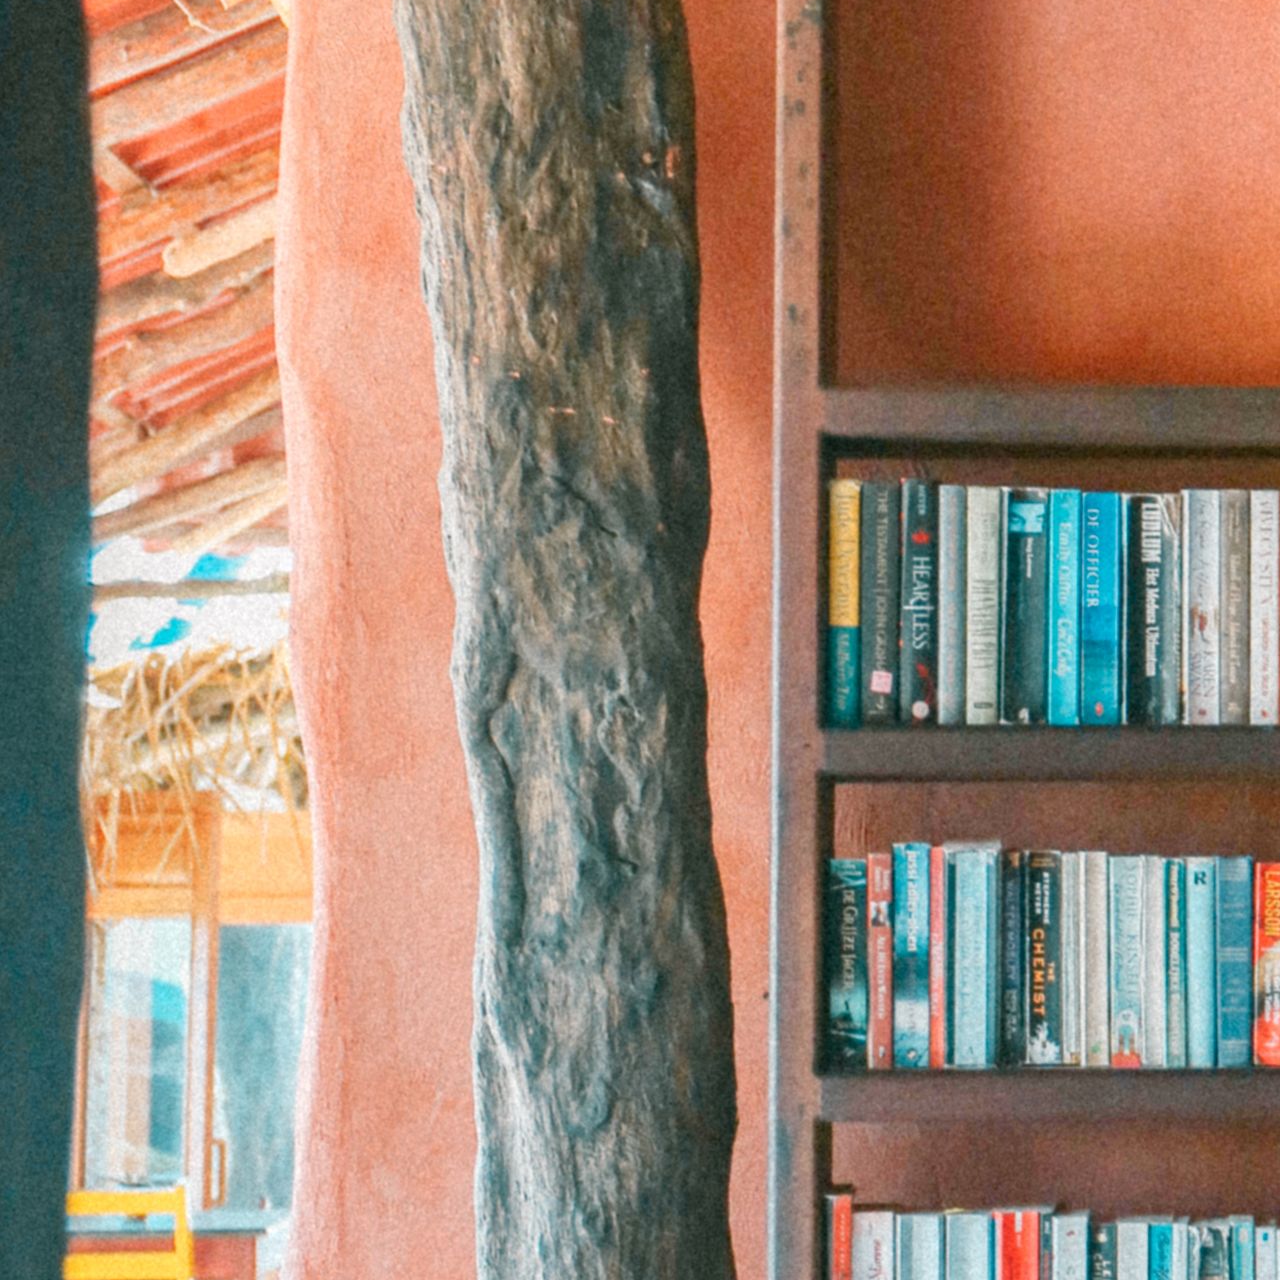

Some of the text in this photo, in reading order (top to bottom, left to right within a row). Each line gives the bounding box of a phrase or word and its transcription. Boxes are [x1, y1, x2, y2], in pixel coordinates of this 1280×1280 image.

[876, 491, 890, 586] THE TESTAMENT
[1086, 508, 1100, 607] DE OFFICIER
[1141, 502, 1162, 563] LUDLUM
[875, 595, 890, 628] JOHN
[906, 556, 933, 650] HEARTLESS
[1146, 587, 1161, 624] Medusa
[1146, 626, 1161, 677] Ultimatum
[843, 889, 856, 904] DE
[1265, 870, 1280, 937] LARSSON
[1005, 930, 1017, 980] MOSLEY
[1127, 864, 1141, 1011] SOPHIE KINSELLA
[843, 954, 857, 990] JAGER
[1032, 927, 1045, 1017] CHEMIST
[1047, 961, 1055, 983] THE
